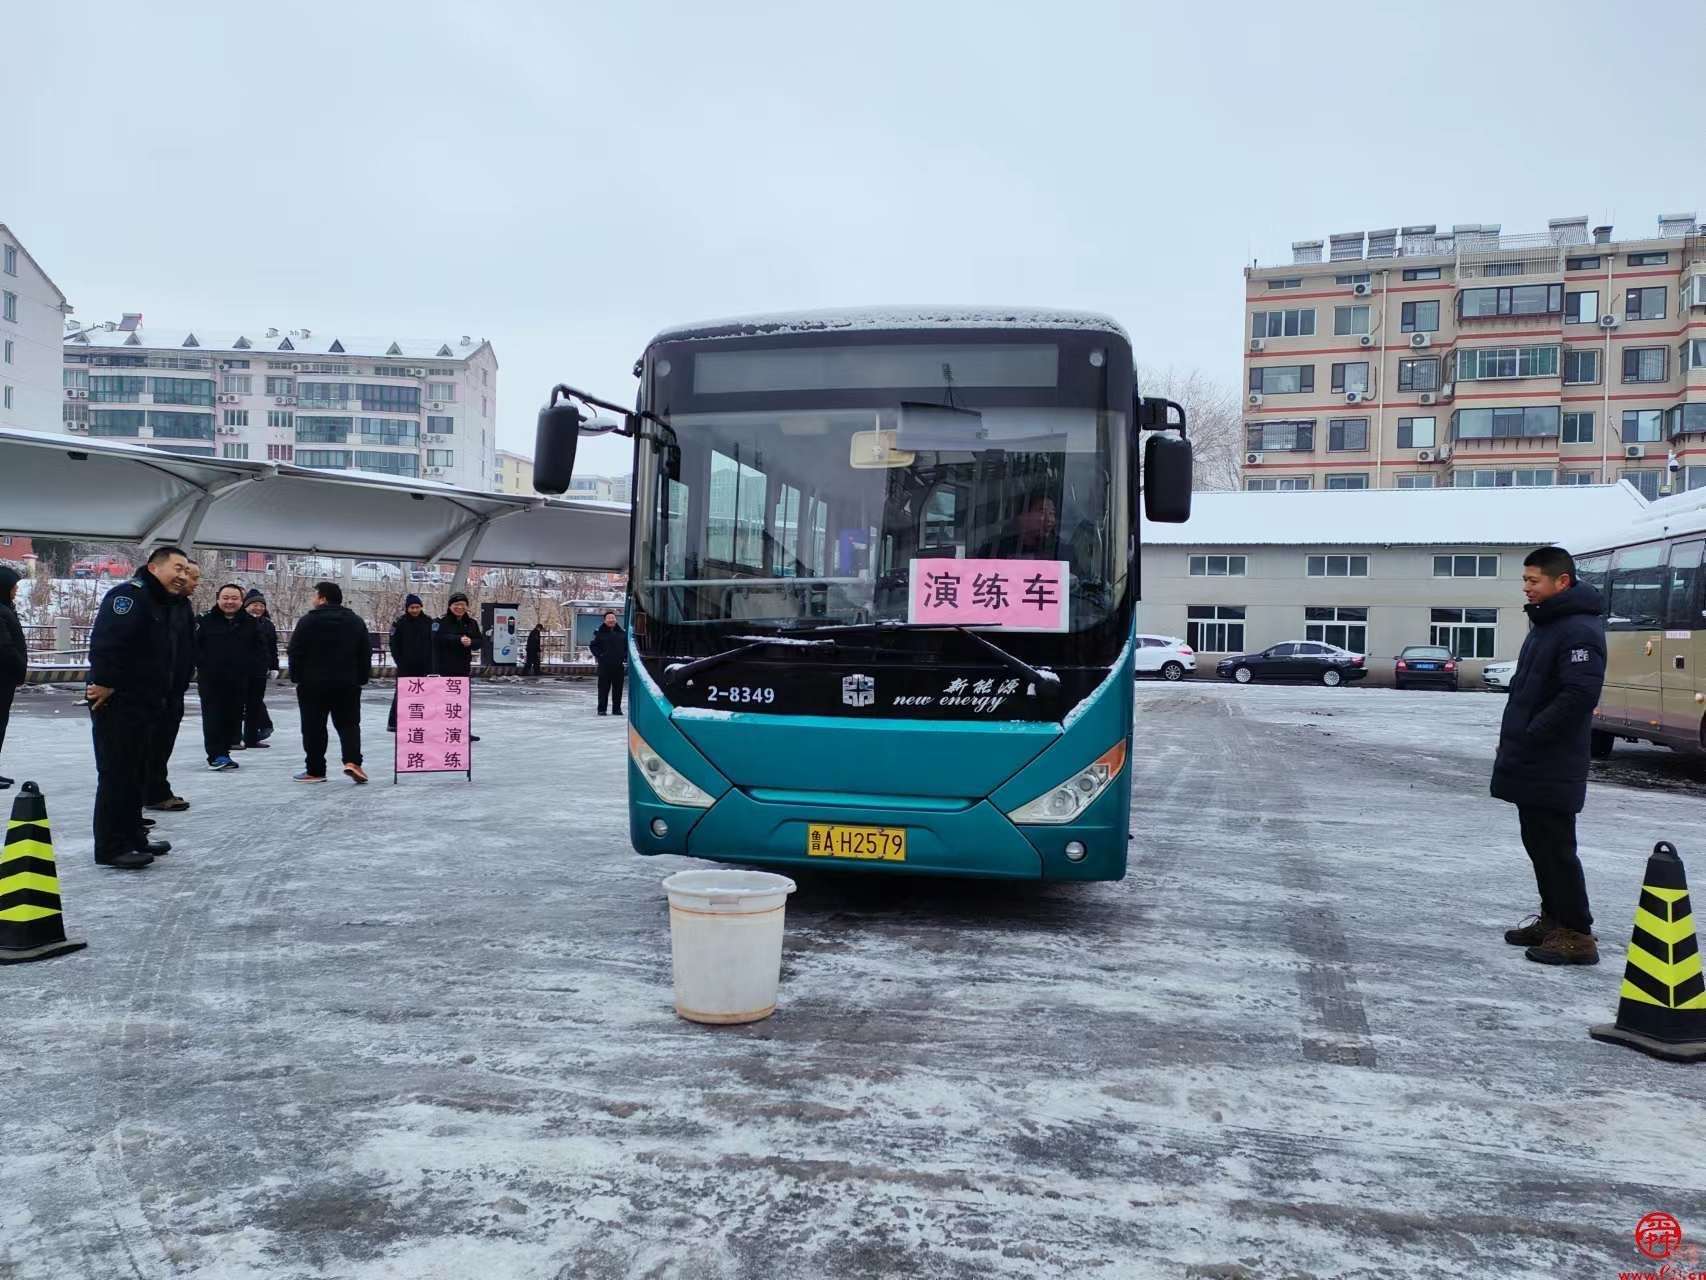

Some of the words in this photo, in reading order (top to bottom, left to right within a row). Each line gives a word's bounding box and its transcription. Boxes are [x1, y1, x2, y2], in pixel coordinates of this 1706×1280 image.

[923, 571, 1059, 611] 演练车
[707, 685, 775, 703] 2-8349
[942, 678, 1020, 696] 新能源
[893, 695, 934, 706] new
[939, 695, 1007, 713] energy
[407, 678, 425, 769] 冰雪道路
[444, 678, 462, 768] 驾驶演练
